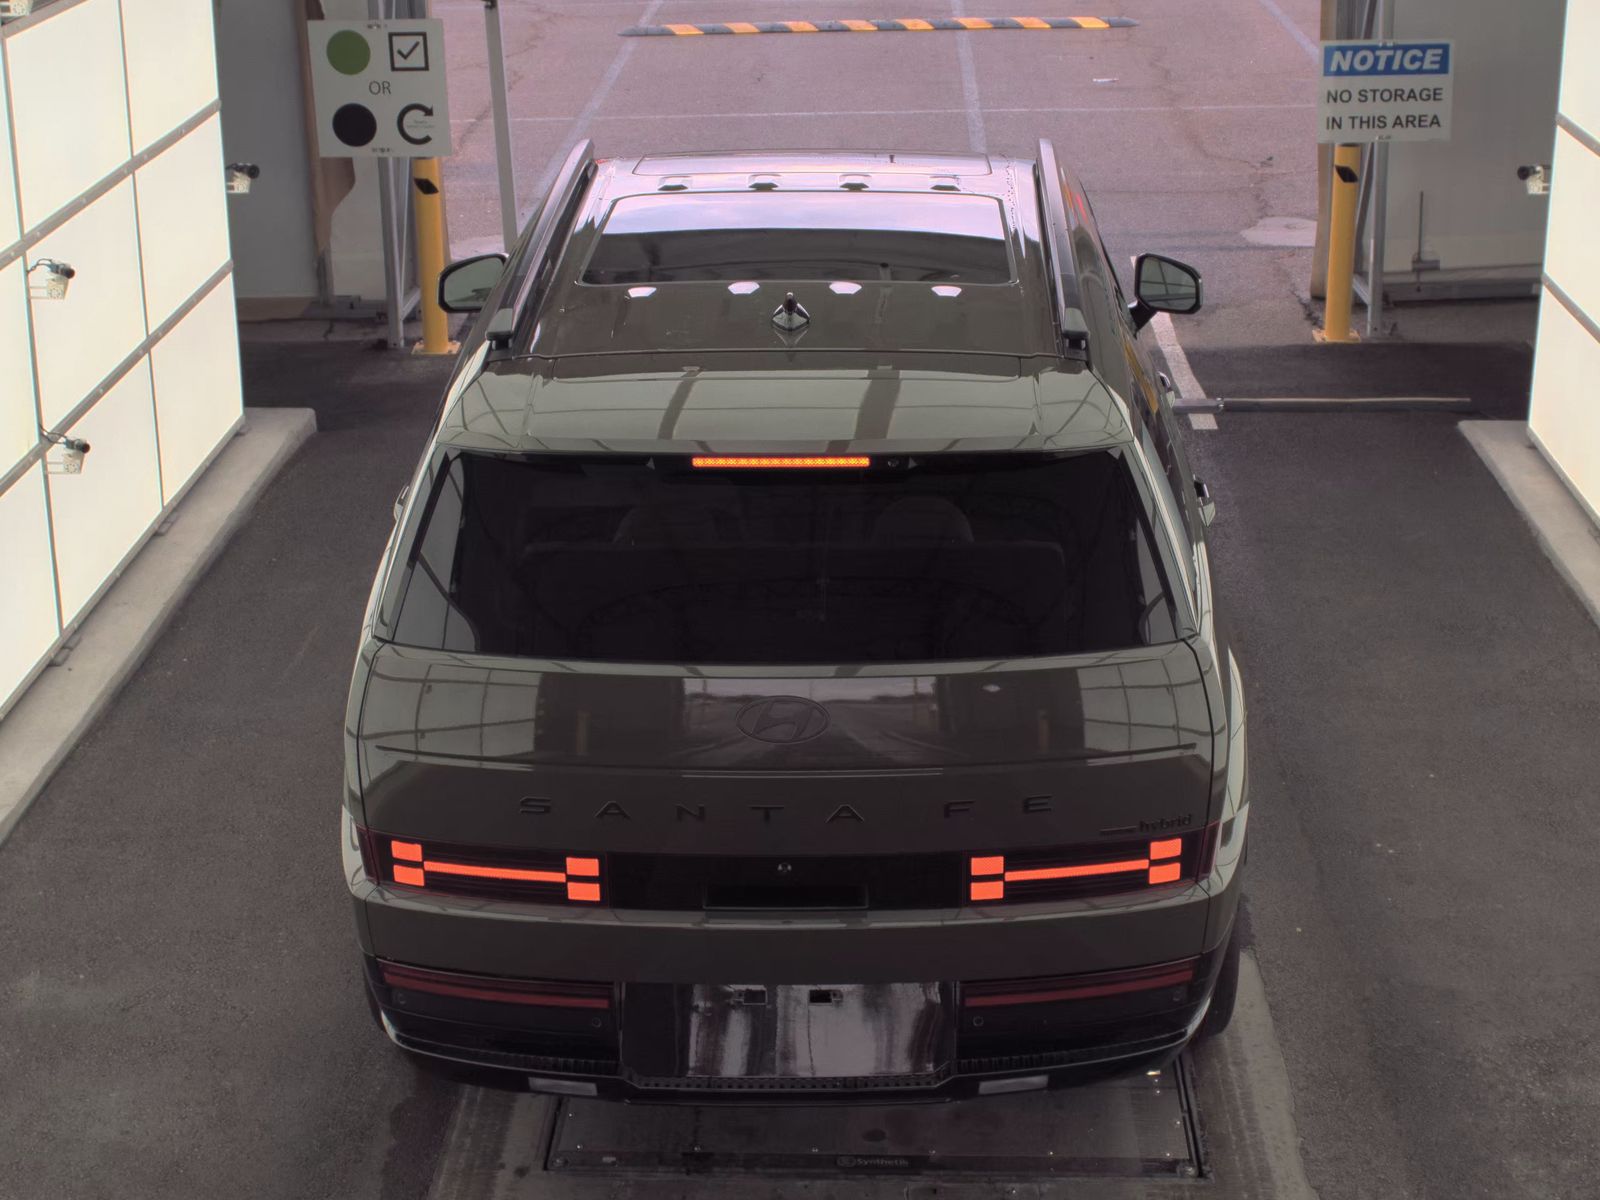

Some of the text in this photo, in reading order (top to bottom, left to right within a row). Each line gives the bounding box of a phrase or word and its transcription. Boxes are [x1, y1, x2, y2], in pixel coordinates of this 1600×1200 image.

[1330, 48, 1444, 72] NOTICE
[368, 81, 392, 95] OR
[1326, 87, 1444, 103] NO STORAGE
[1326, 114, 1441, 130] IN THIS AREA
[519, 794, 1053, 824] SANTA FE
